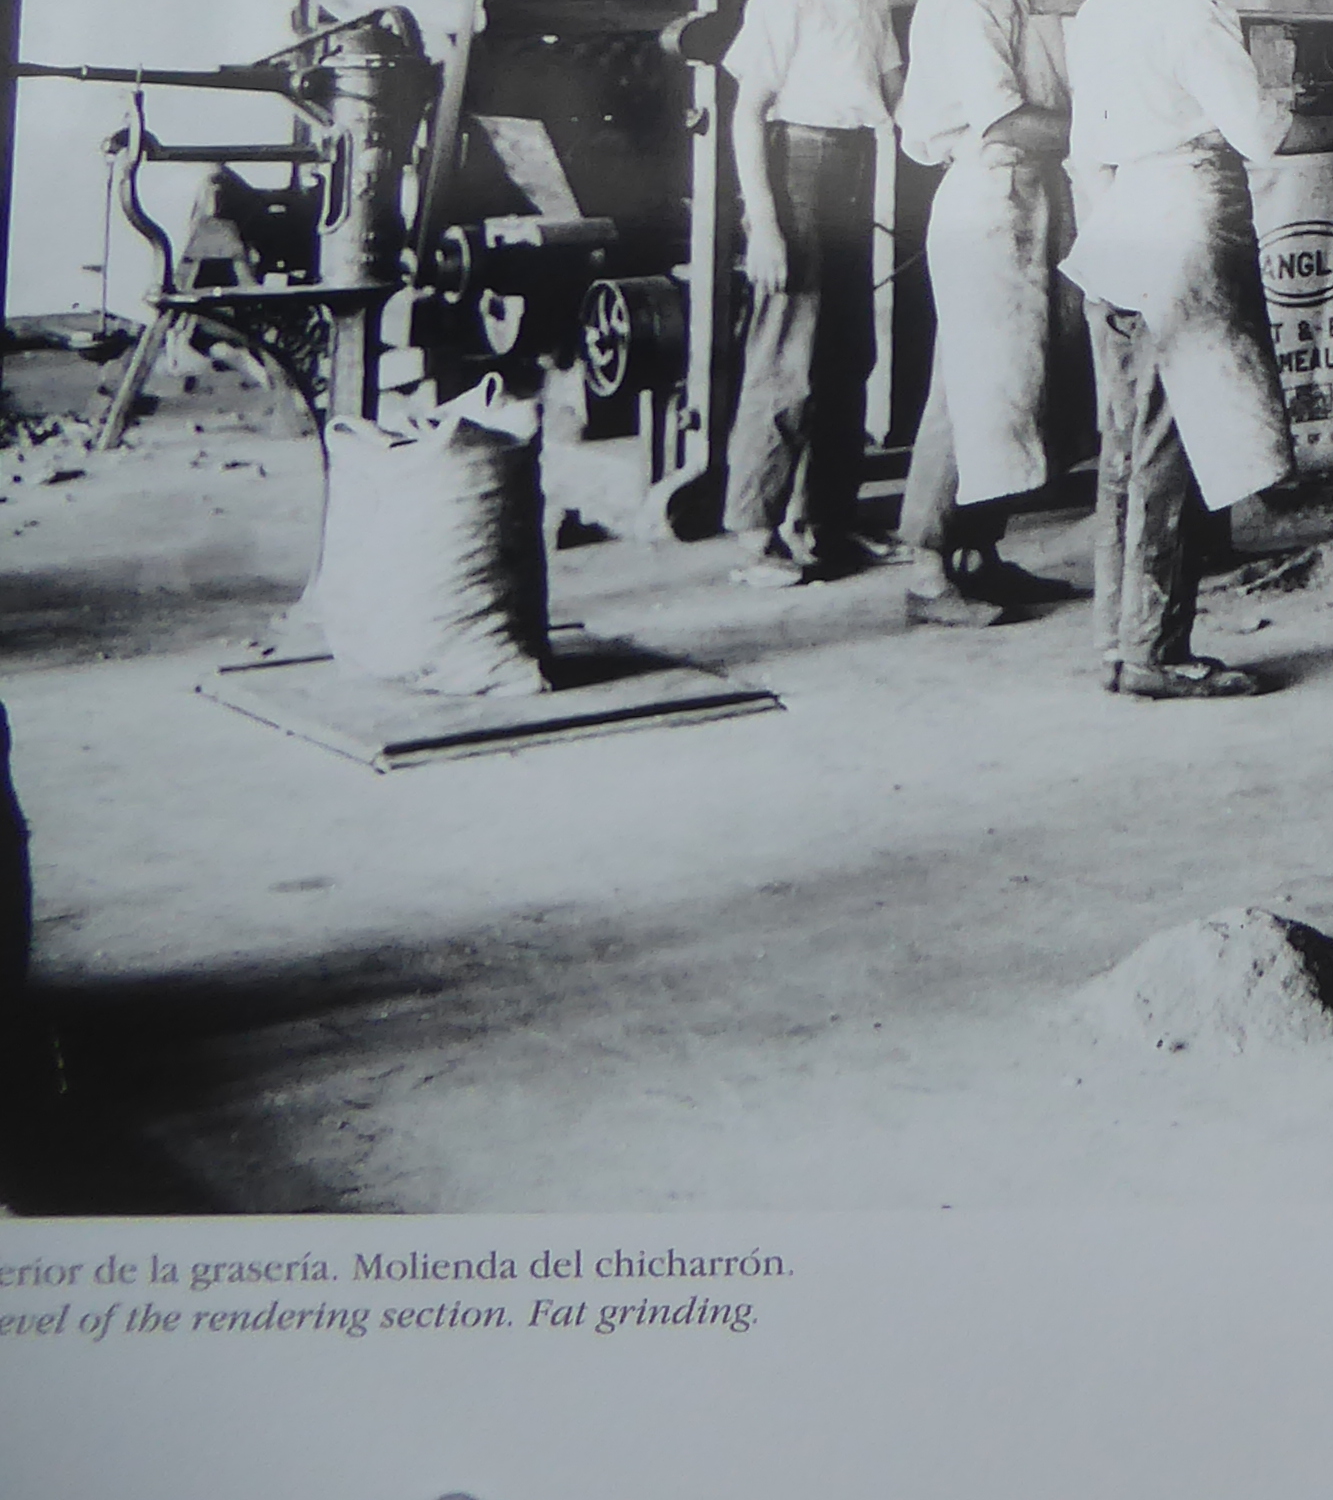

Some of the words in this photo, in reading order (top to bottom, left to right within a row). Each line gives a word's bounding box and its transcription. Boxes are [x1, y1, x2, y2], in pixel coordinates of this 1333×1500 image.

[0, 1257, 84, 1288] erior
[94, 1254, 138, 1285] de
[150, 1253, 179, 1284] la
[190, 1251, 338, 1291] grasería.
[353, 1249, 518, 1282] Molienda
[529, 1248, 583, 1280] del
[594, 1247, 794, 1280] chicharrón.
[0, 1303, 71, 1337] evel
[78, 1303, 121, 1343] of
[126, 1302, 182, 1334] the
[192, 1300, 371, 1338] rendering
[379, 1300, 513, 1329] section.
[527, 1299, 588, 1328] Fat
[594, 1296, 758, 1335] grinding.
